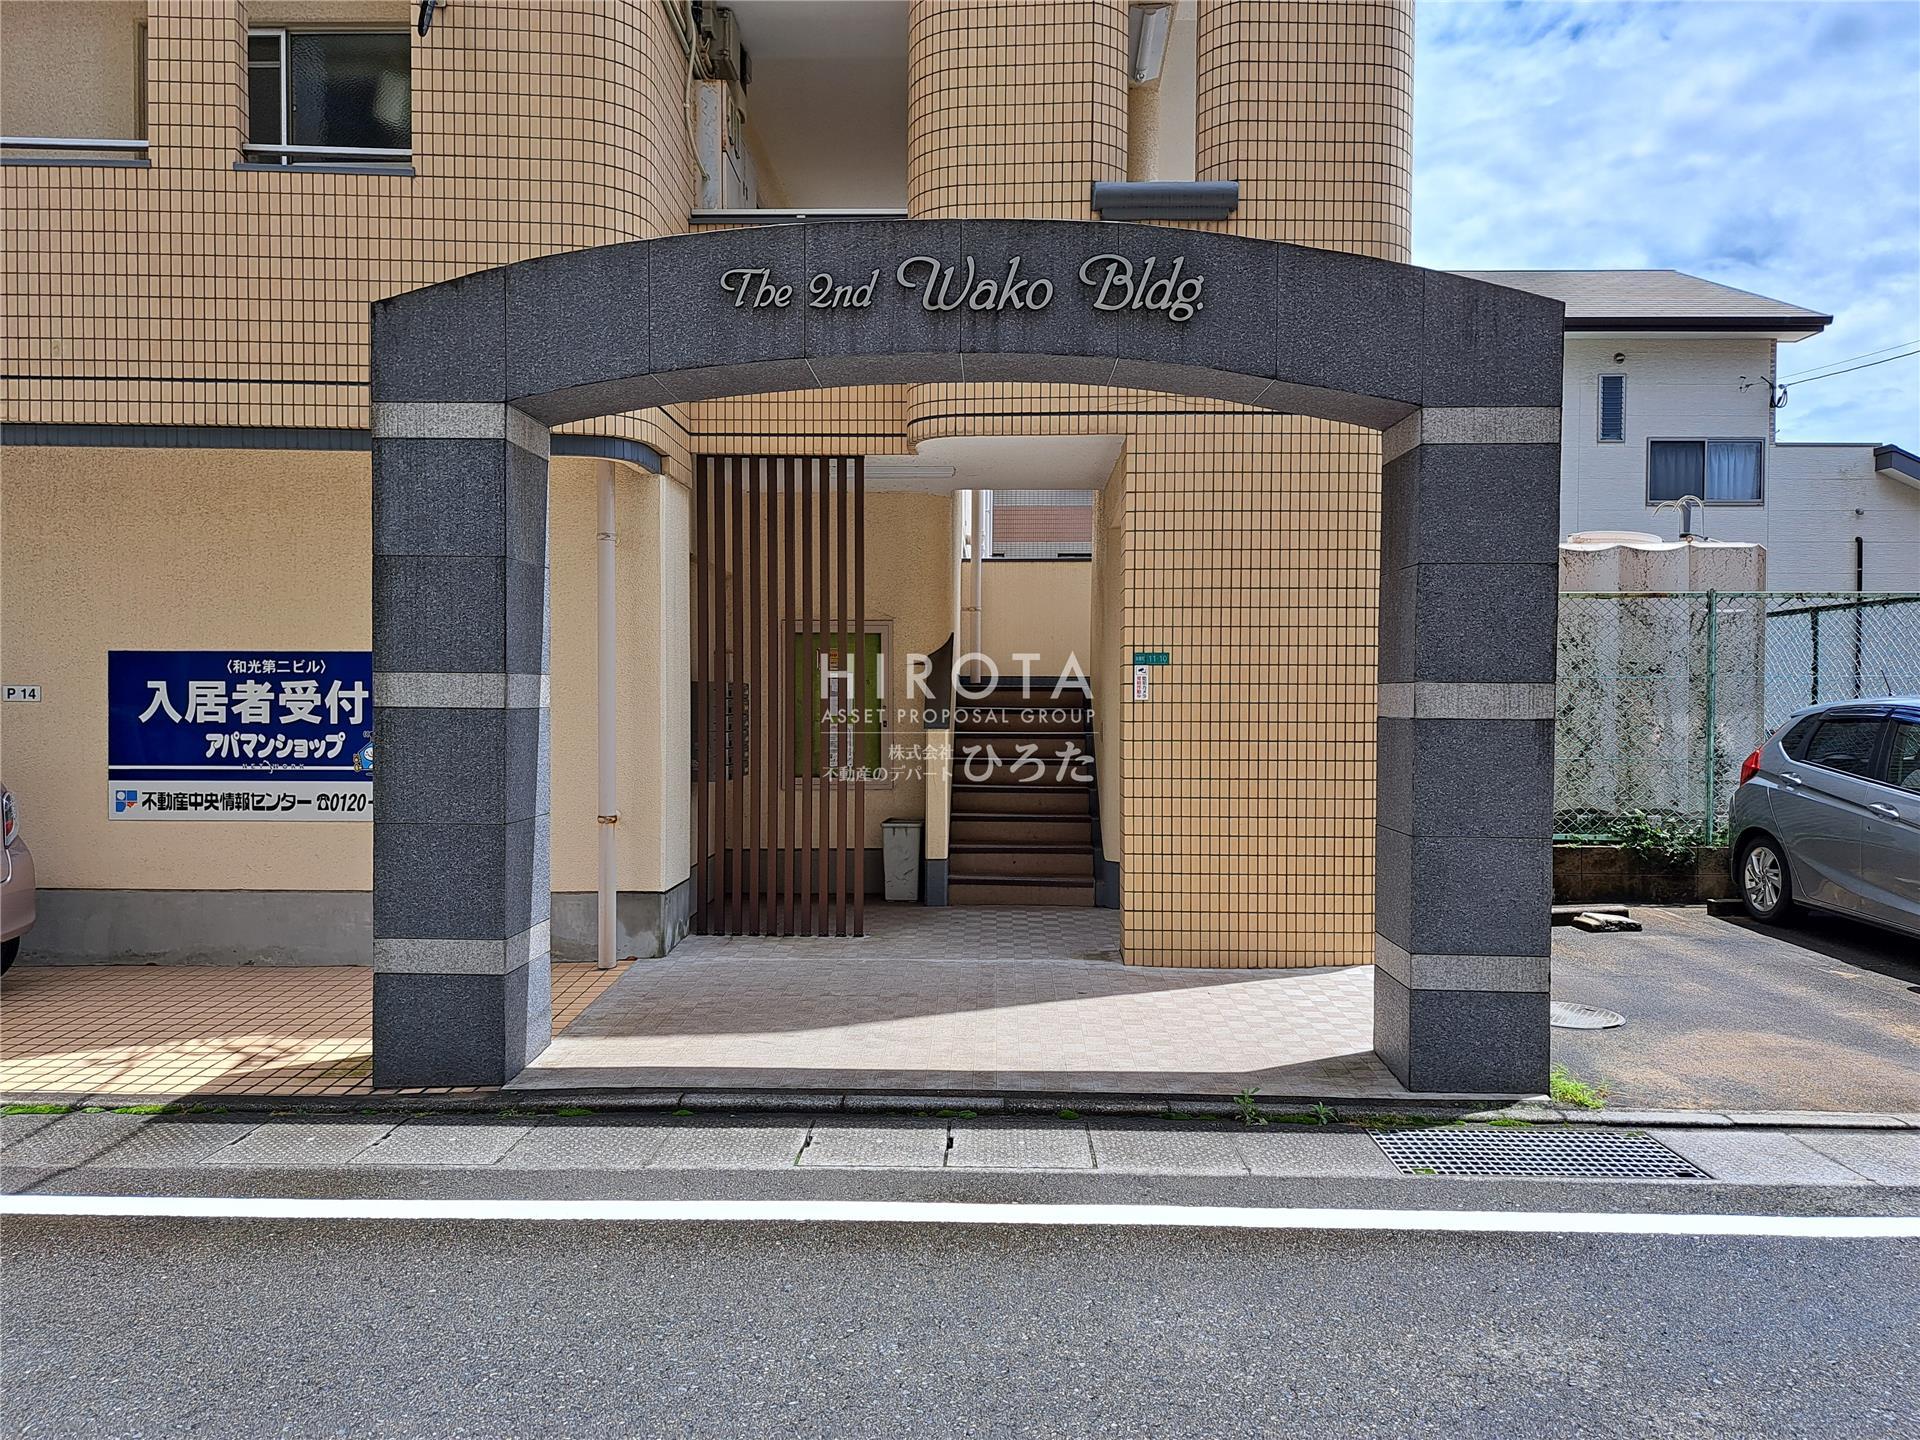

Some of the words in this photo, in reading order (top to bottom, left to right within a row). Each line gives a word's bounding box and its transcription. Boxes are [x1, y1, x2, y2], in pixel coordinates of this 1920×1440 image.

[720, 267, 793, 309] The
[809, 269, 880, 309] 2nd
[897, 255, 1054, 311] Wako
[1079, 254, 1205, 322] Bldg.
[7, 688, 16, 700] P
[20, 688, 37, 700] 14
[138, 680, 369, 725] 入居者受付
[205, 731, 346, 759] アパマンショップ
[141, 791, 312, 811] 不動産中央情報センター
